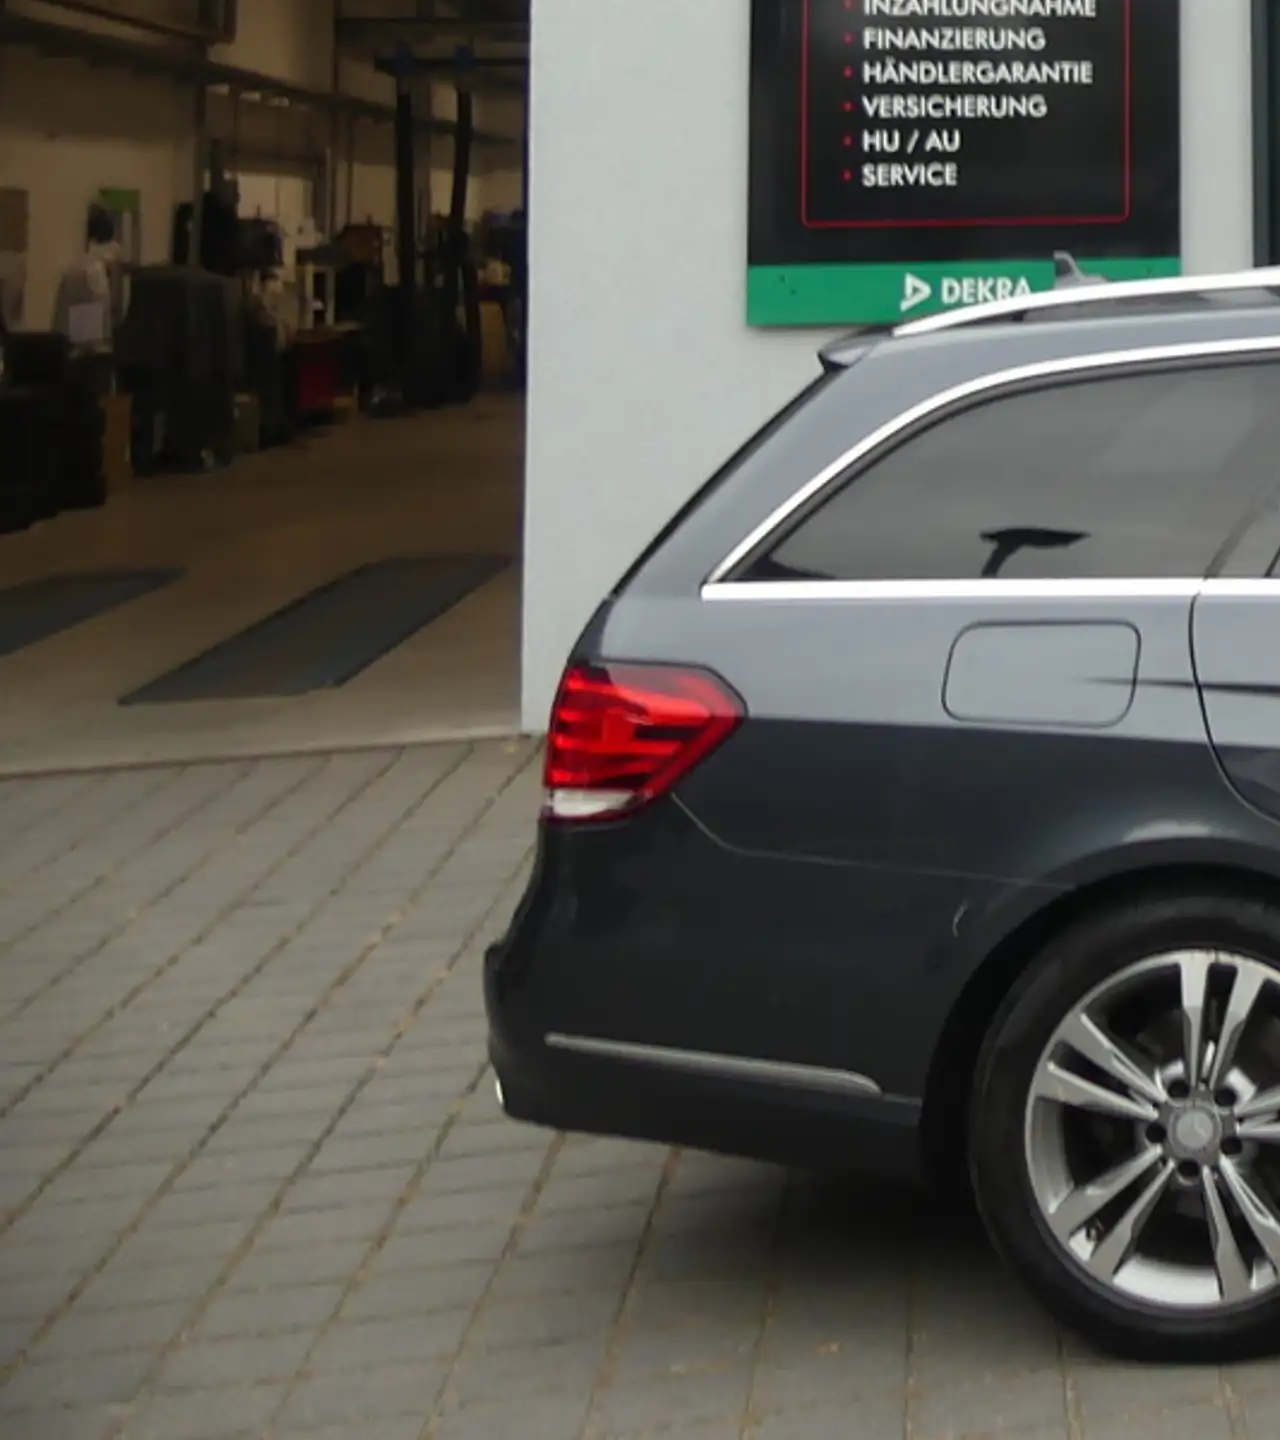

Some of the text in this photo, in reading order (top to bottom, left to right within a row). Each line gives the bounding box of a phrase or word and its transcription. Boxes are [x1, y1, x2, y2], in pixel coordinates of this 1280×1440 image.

[863, 28, 1046, 50] FINANZIERUNG
[863, 57, 1093, 84] HÄNDLERGARANTIE
[862, 95, 1047, 118] VERSICHERUNG
[863, 130, 960, 154] HU / AU
[862, 163, 958, 186] SERVICE
[941, 276, 1032, 304] DEKRA
